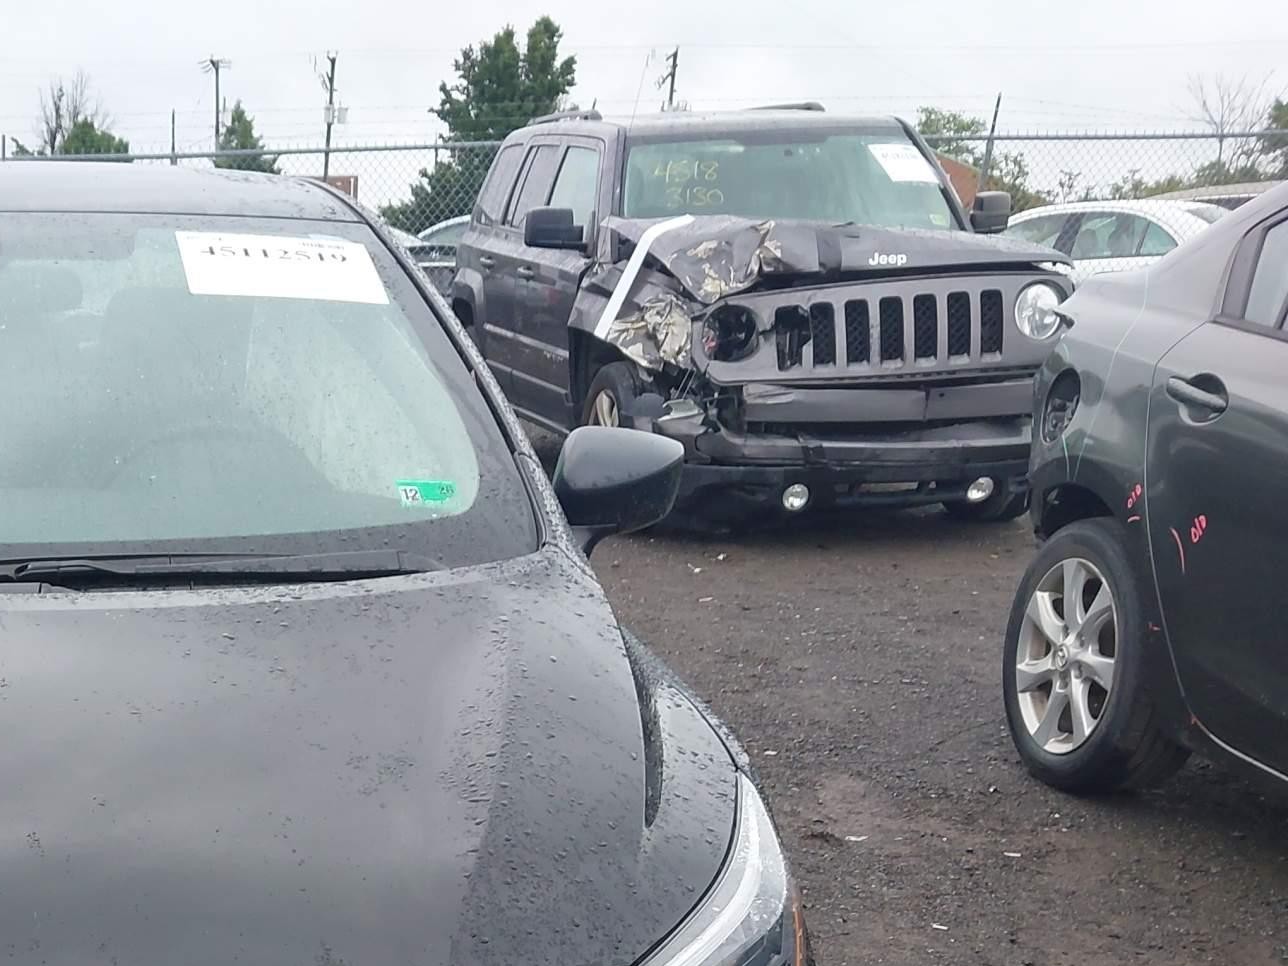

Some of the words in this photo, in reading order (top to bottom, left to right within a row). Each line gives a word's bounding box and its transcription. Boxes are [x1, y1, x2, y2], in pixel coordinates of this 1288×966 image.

[200, 244, 348, 264] 45112519
[868, 251, 908, 267] Jeep
[402, 488, 420, 501] 12
